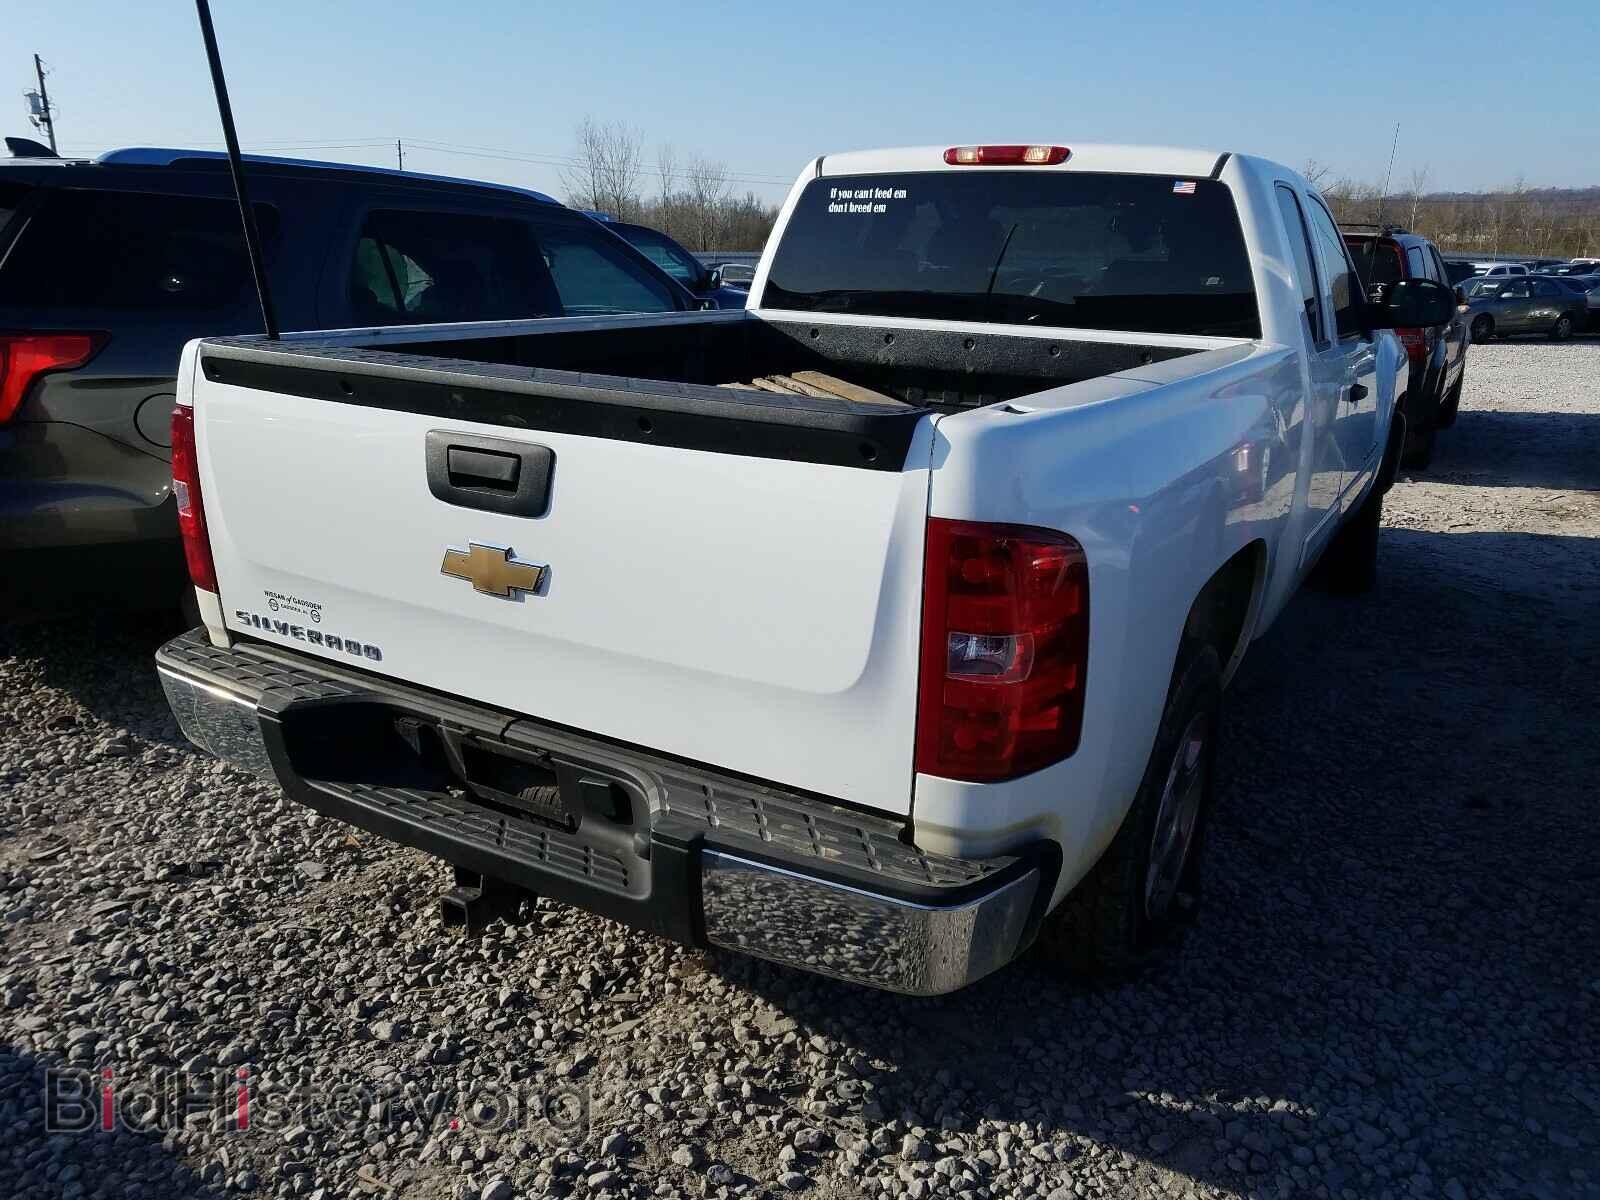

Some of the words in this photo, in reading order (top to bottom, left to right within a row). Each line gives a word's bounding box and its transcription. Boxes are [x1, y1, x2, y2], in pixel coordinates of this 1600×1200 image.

[838, 190, 852, 200] you
[875, 187, 893, 198] feed
[894, 190, 907, 198] em
[849, 202, 873, 212] breed
[873, 204, 887, 212] em
[263, 590, 286, 601] NISSAN
[235, 610, 383, 662] SILVERADO
